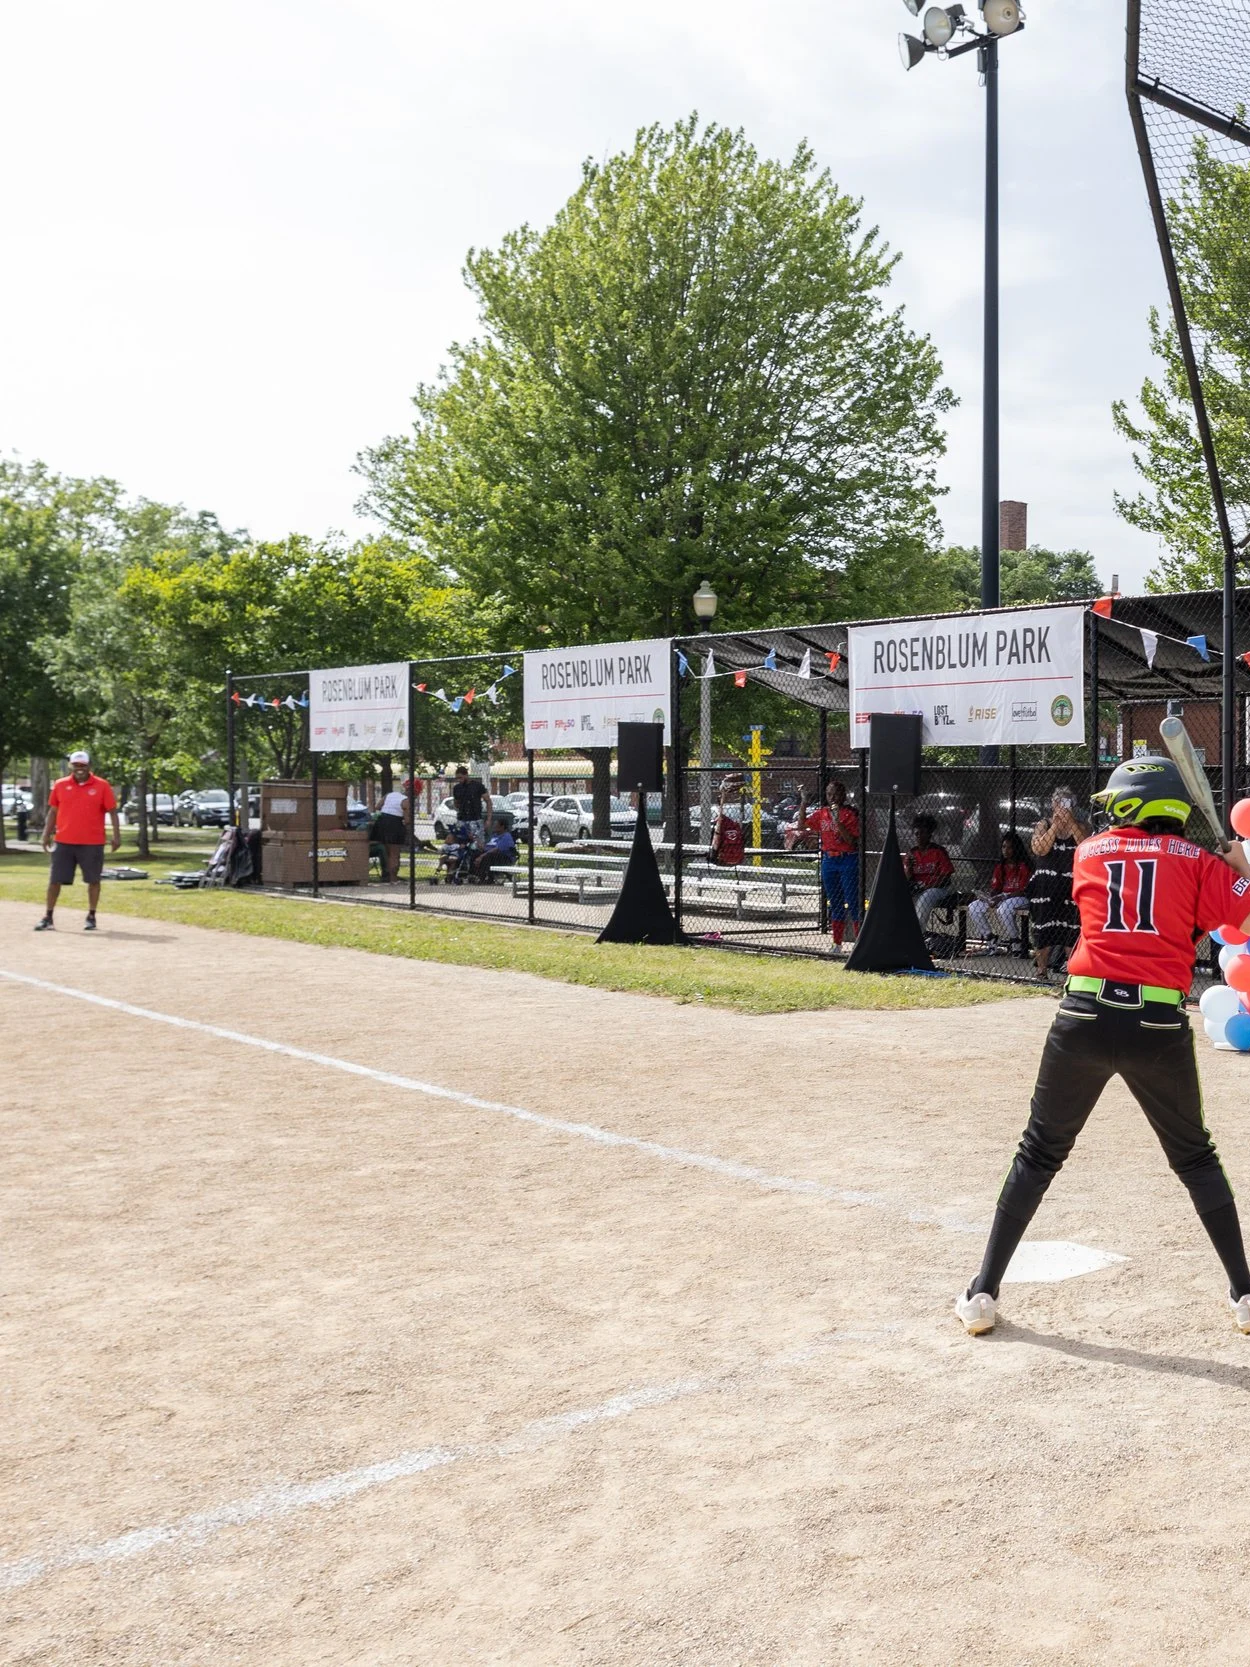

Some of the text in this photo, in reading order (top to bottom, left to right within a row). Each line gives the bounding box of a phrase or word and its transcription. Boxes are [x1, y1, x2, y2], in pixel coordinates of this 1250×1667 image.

[873, 625, 1052, 674] ROSENBLUM PARK
[542, 654, 653, 690] ROSENBLUM PARK
[322, 675, 398, 702] ROSENBLUM PARK
[933, 705, 948, 716] LOST
[974, 708, 997, 720] RISE
[1124, 837, 1163, 853] LIVES
[1167, 838, 1201, 859] HERE
[1101, 859, 1161, 935] 11
